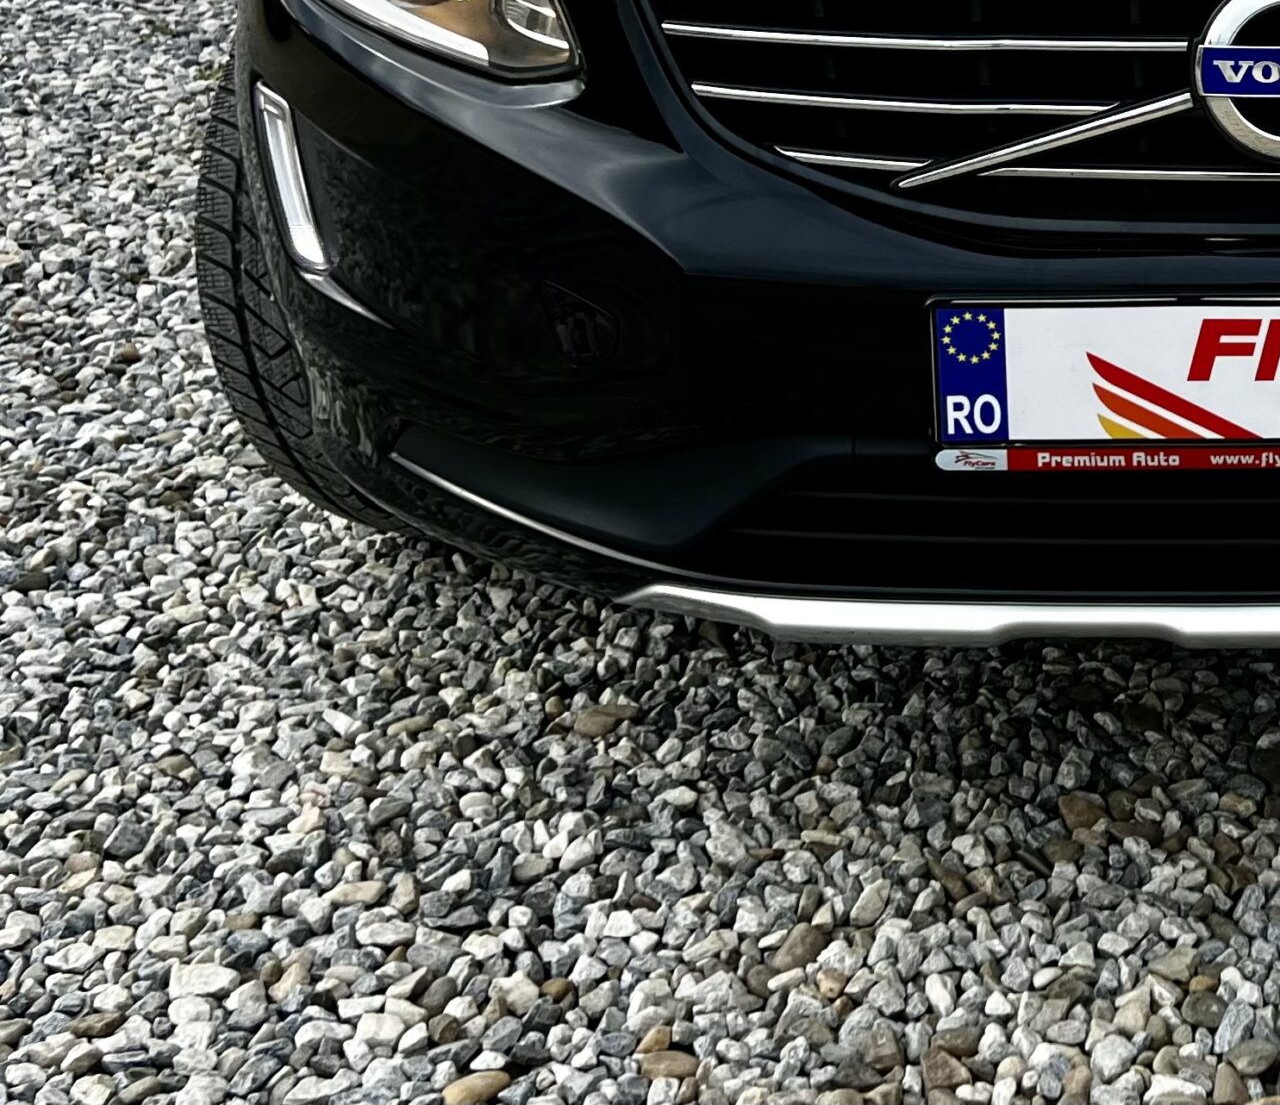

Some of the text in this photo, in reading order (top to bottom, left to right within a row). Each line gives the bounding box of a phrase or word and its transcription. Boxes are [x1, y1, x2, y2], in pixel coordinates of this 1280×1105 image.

[946, 393, 1002, 435] RO
[1037, 451, 1126, 468] Premium
[1132, 451, 1180, 467] Auto
